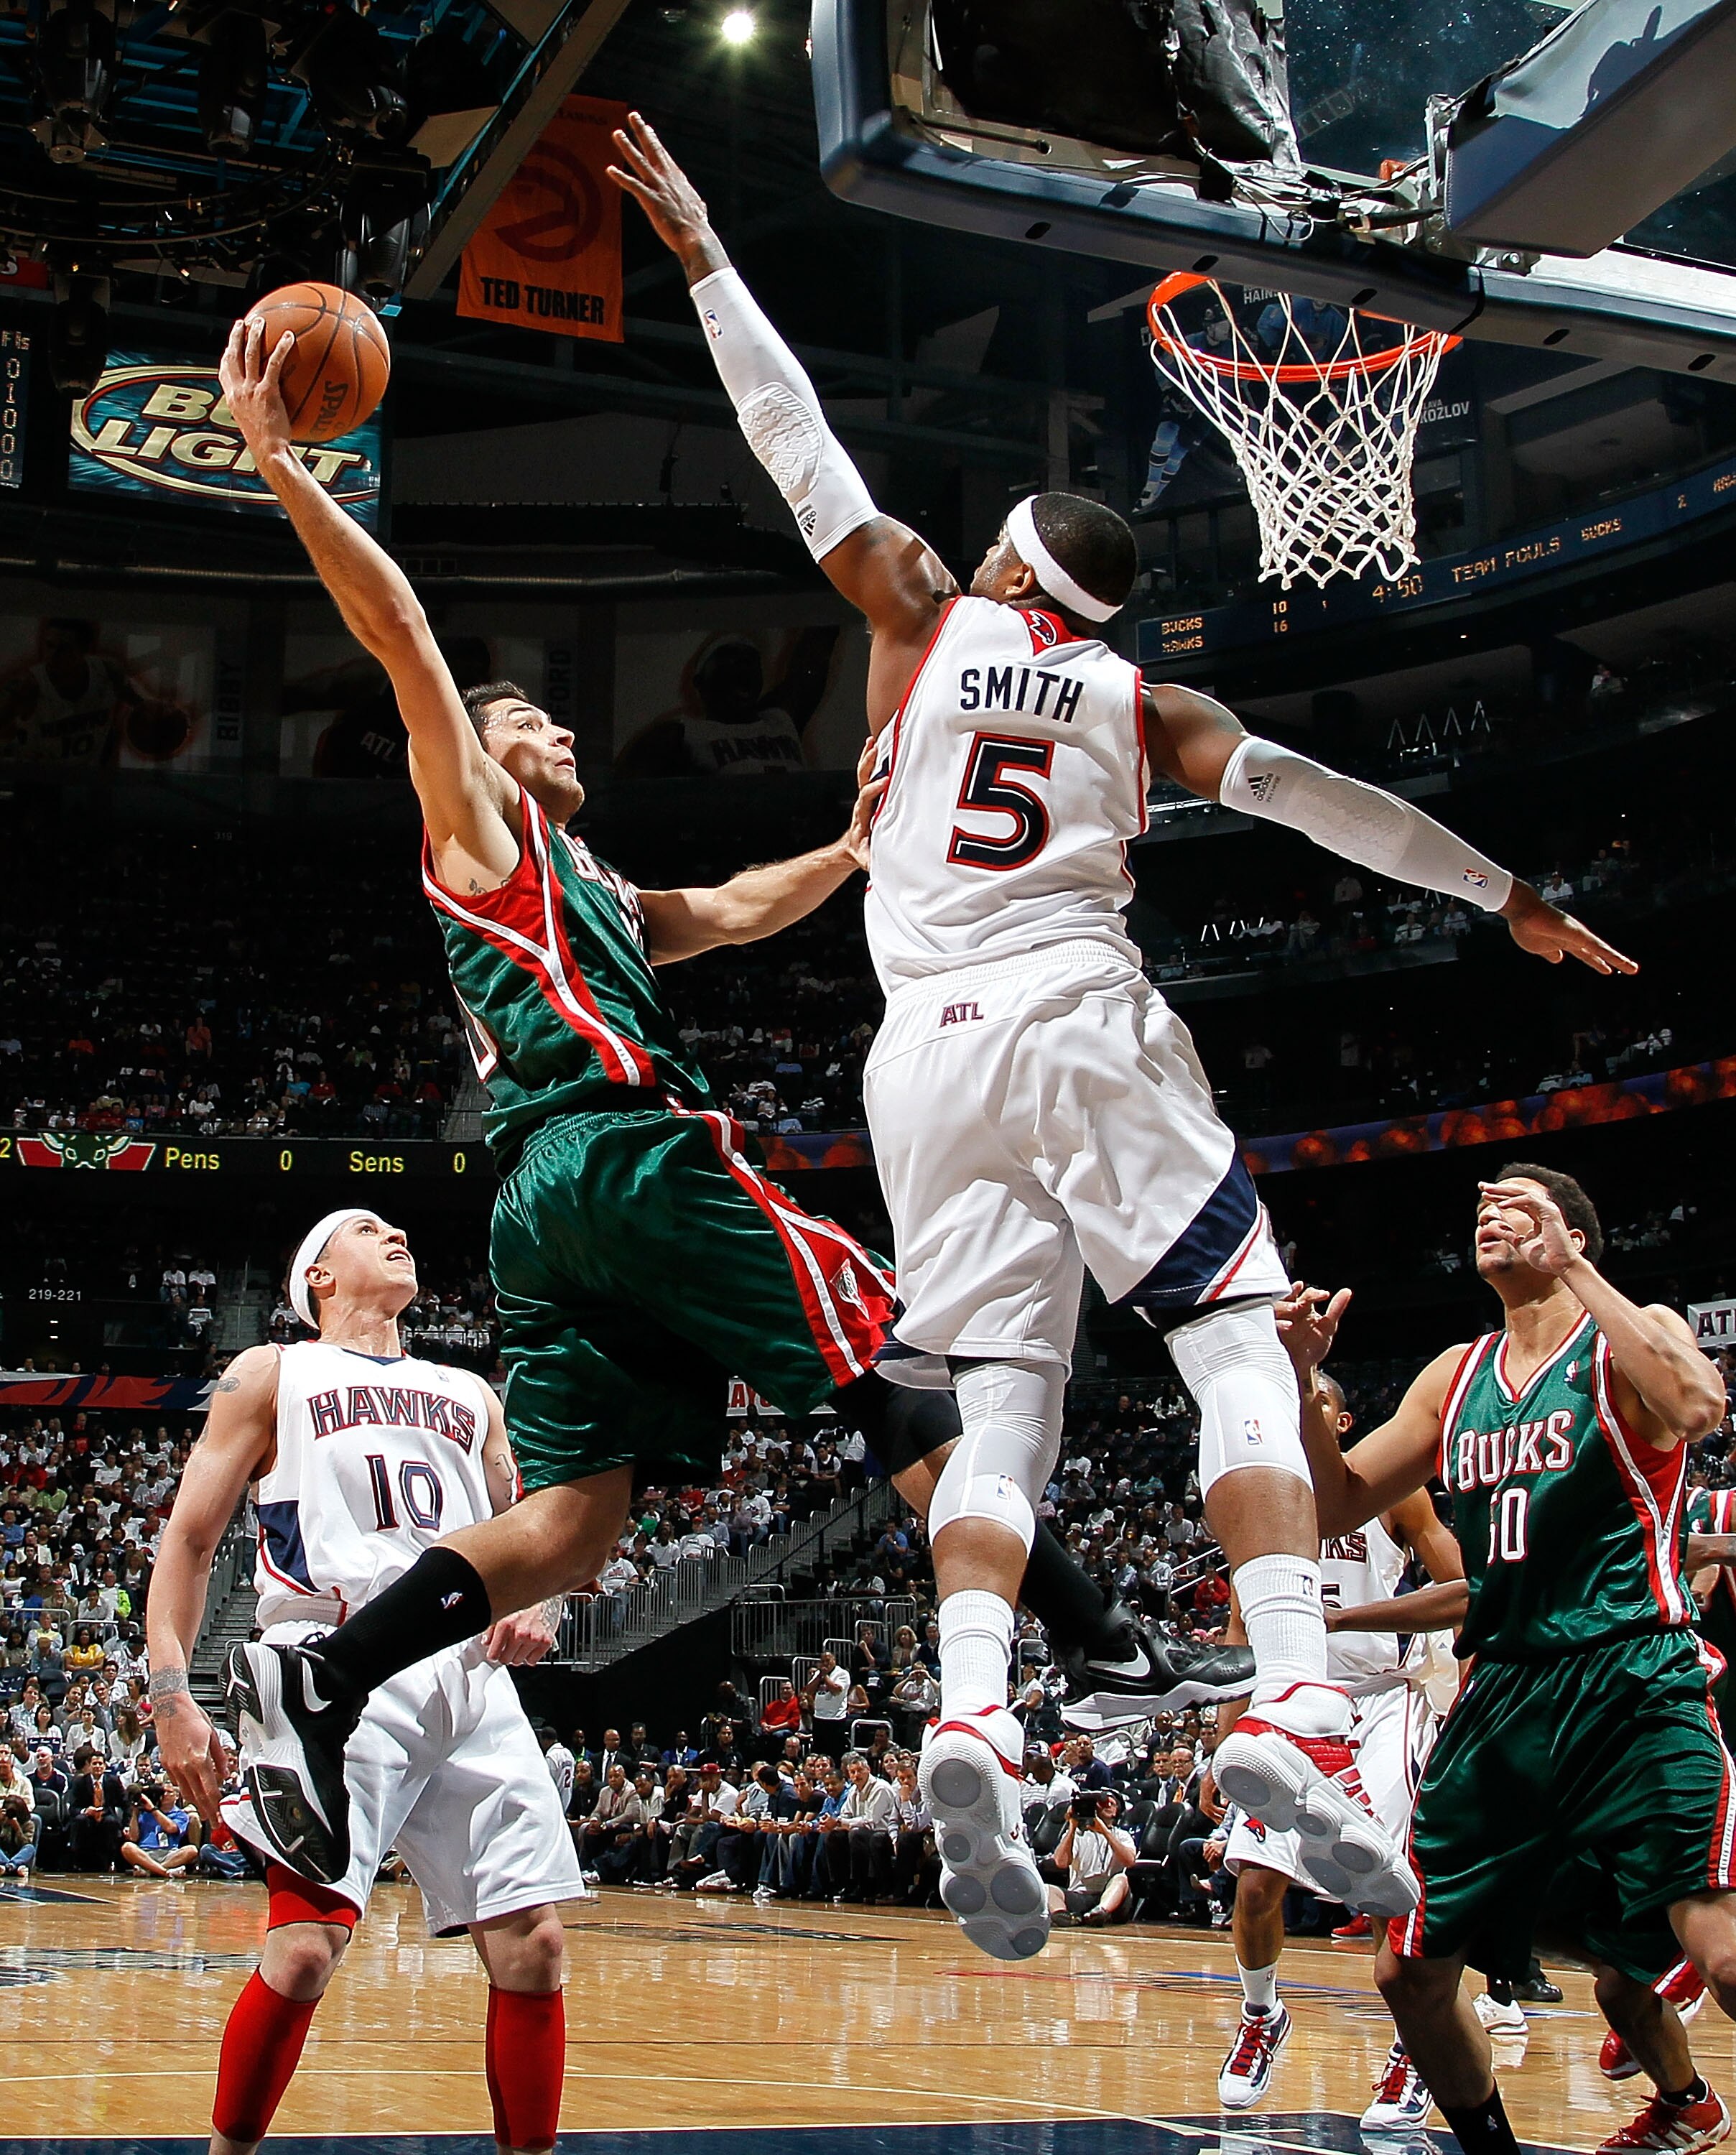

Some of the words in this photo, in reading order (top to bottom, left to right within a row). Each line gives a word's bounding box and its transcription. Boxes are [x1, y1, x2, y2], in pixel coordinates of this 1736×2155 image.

[481, 277, 519, 310] TED
[524, 285, 605, 325] TURNER
[1243, 289, 1279, 305] HAIN
[1420, 401, 1470, 424] KOZLOV
[1452, 556, 1497, 583] TEAM
[1505, 537, 1561, 567] FOULS
[1372, 575, 1424, 603] 4:50
[1161, 616, 1203, 634] BUCKS
[1273, 600, 1288, 615] 10
[1273, 620, 1288, 633] 16
[960, 666, 1085, 723] SMITH
[945, 730, 1056, 872] 5
[938, 1001, 984, 1029] ATL
[165, 1146, 220, 1170] Pens
[280, 1150, 292, 1171] 0
[349, 1150, 404, 1173] Sens
[453, 1152, 466, 1174] 0
[29, 1288, 82, 1302] 219-221
[1696, 1308, 1736, 1338] AT
[307, 1386, 475, 1456] HAWKS
[1457, 1409, 1576, 1493] BUCKS
[364, 1454, 443, 1532] 10
